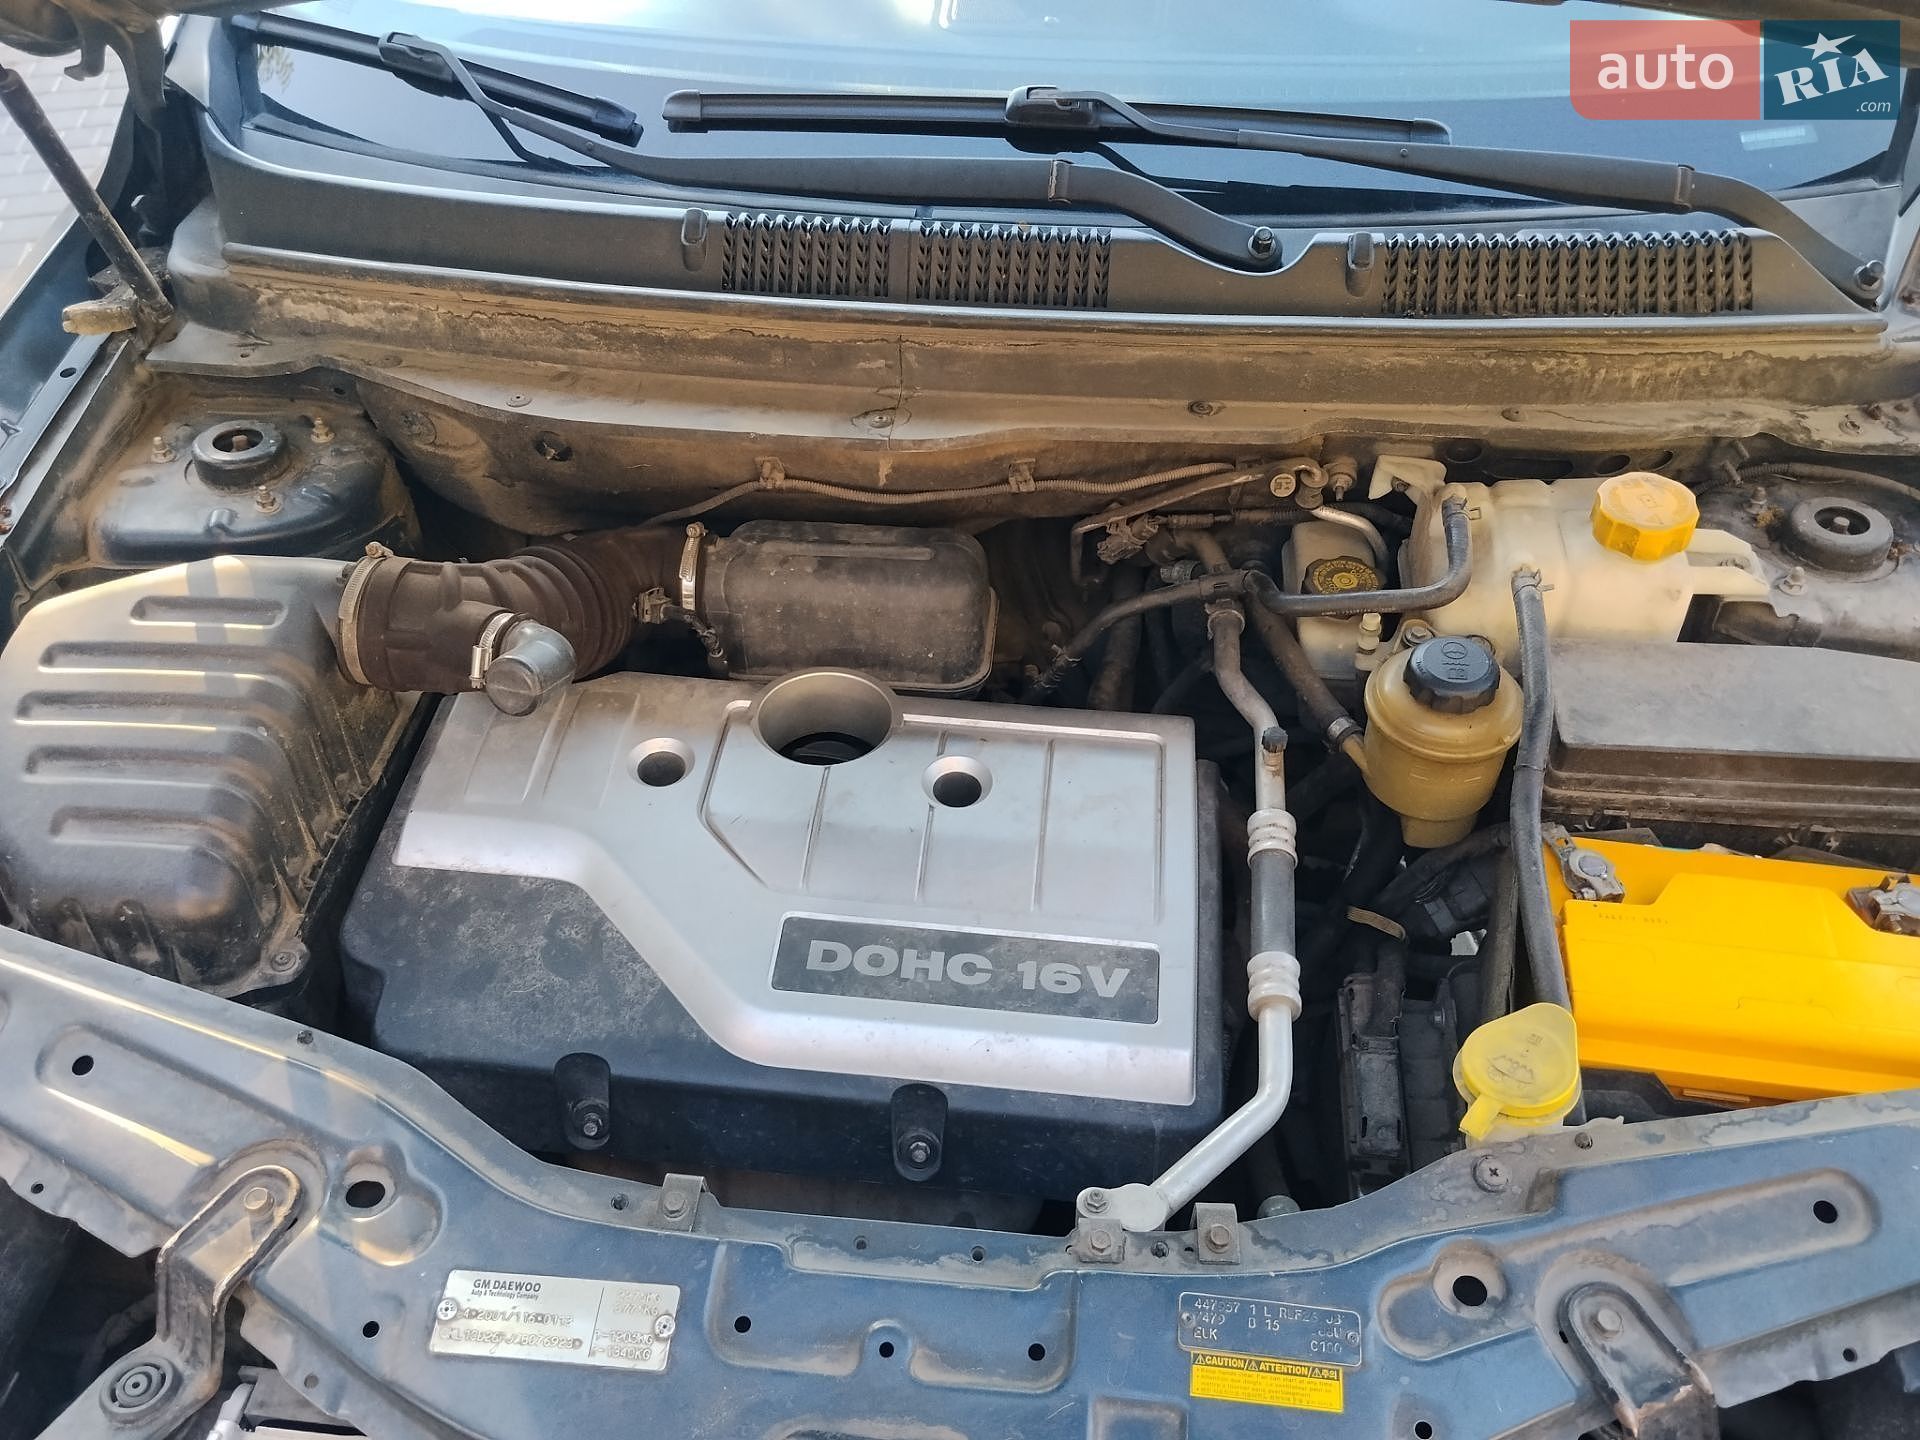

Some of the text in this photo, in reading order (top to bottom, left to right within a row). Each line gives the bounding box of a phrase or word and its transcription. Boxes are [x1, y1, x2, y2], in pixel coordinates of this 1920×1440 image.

[806, 939, 1130, 998] DOHC 16V
[473, 1279, 541, 1292] GM DAEWOO
[471, 1289, 483, 1297] Auto
[488, 1290, 515, 1299] Technology
[516, 1292, 539, 1301] Company
